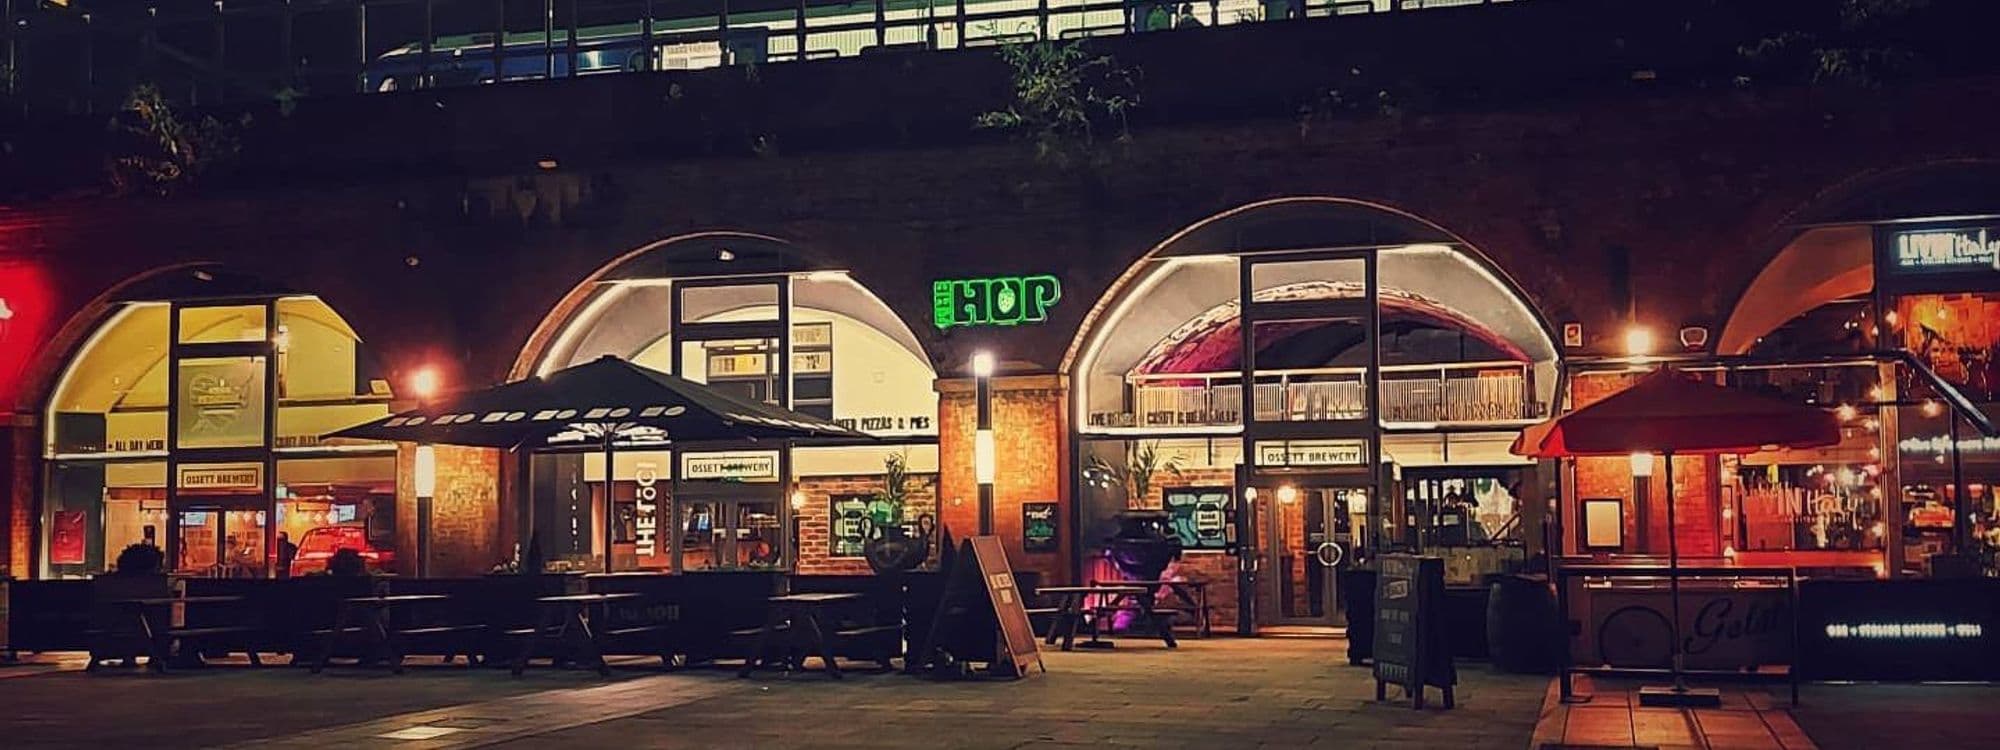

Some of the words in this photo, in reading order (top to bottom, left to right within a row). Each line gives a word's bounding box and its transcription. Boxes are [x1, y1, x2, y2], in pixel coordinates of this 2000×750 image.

[934, 281, 953, 327] THE
[953, 275, 1061, 325] HOP
[909, 416, 930, 429] PIES
[1308, 452, 1358, 462] BREWERY
[185, 474, 215, 484] OSSETT
[216, 474, 254, 484] BREWERY
